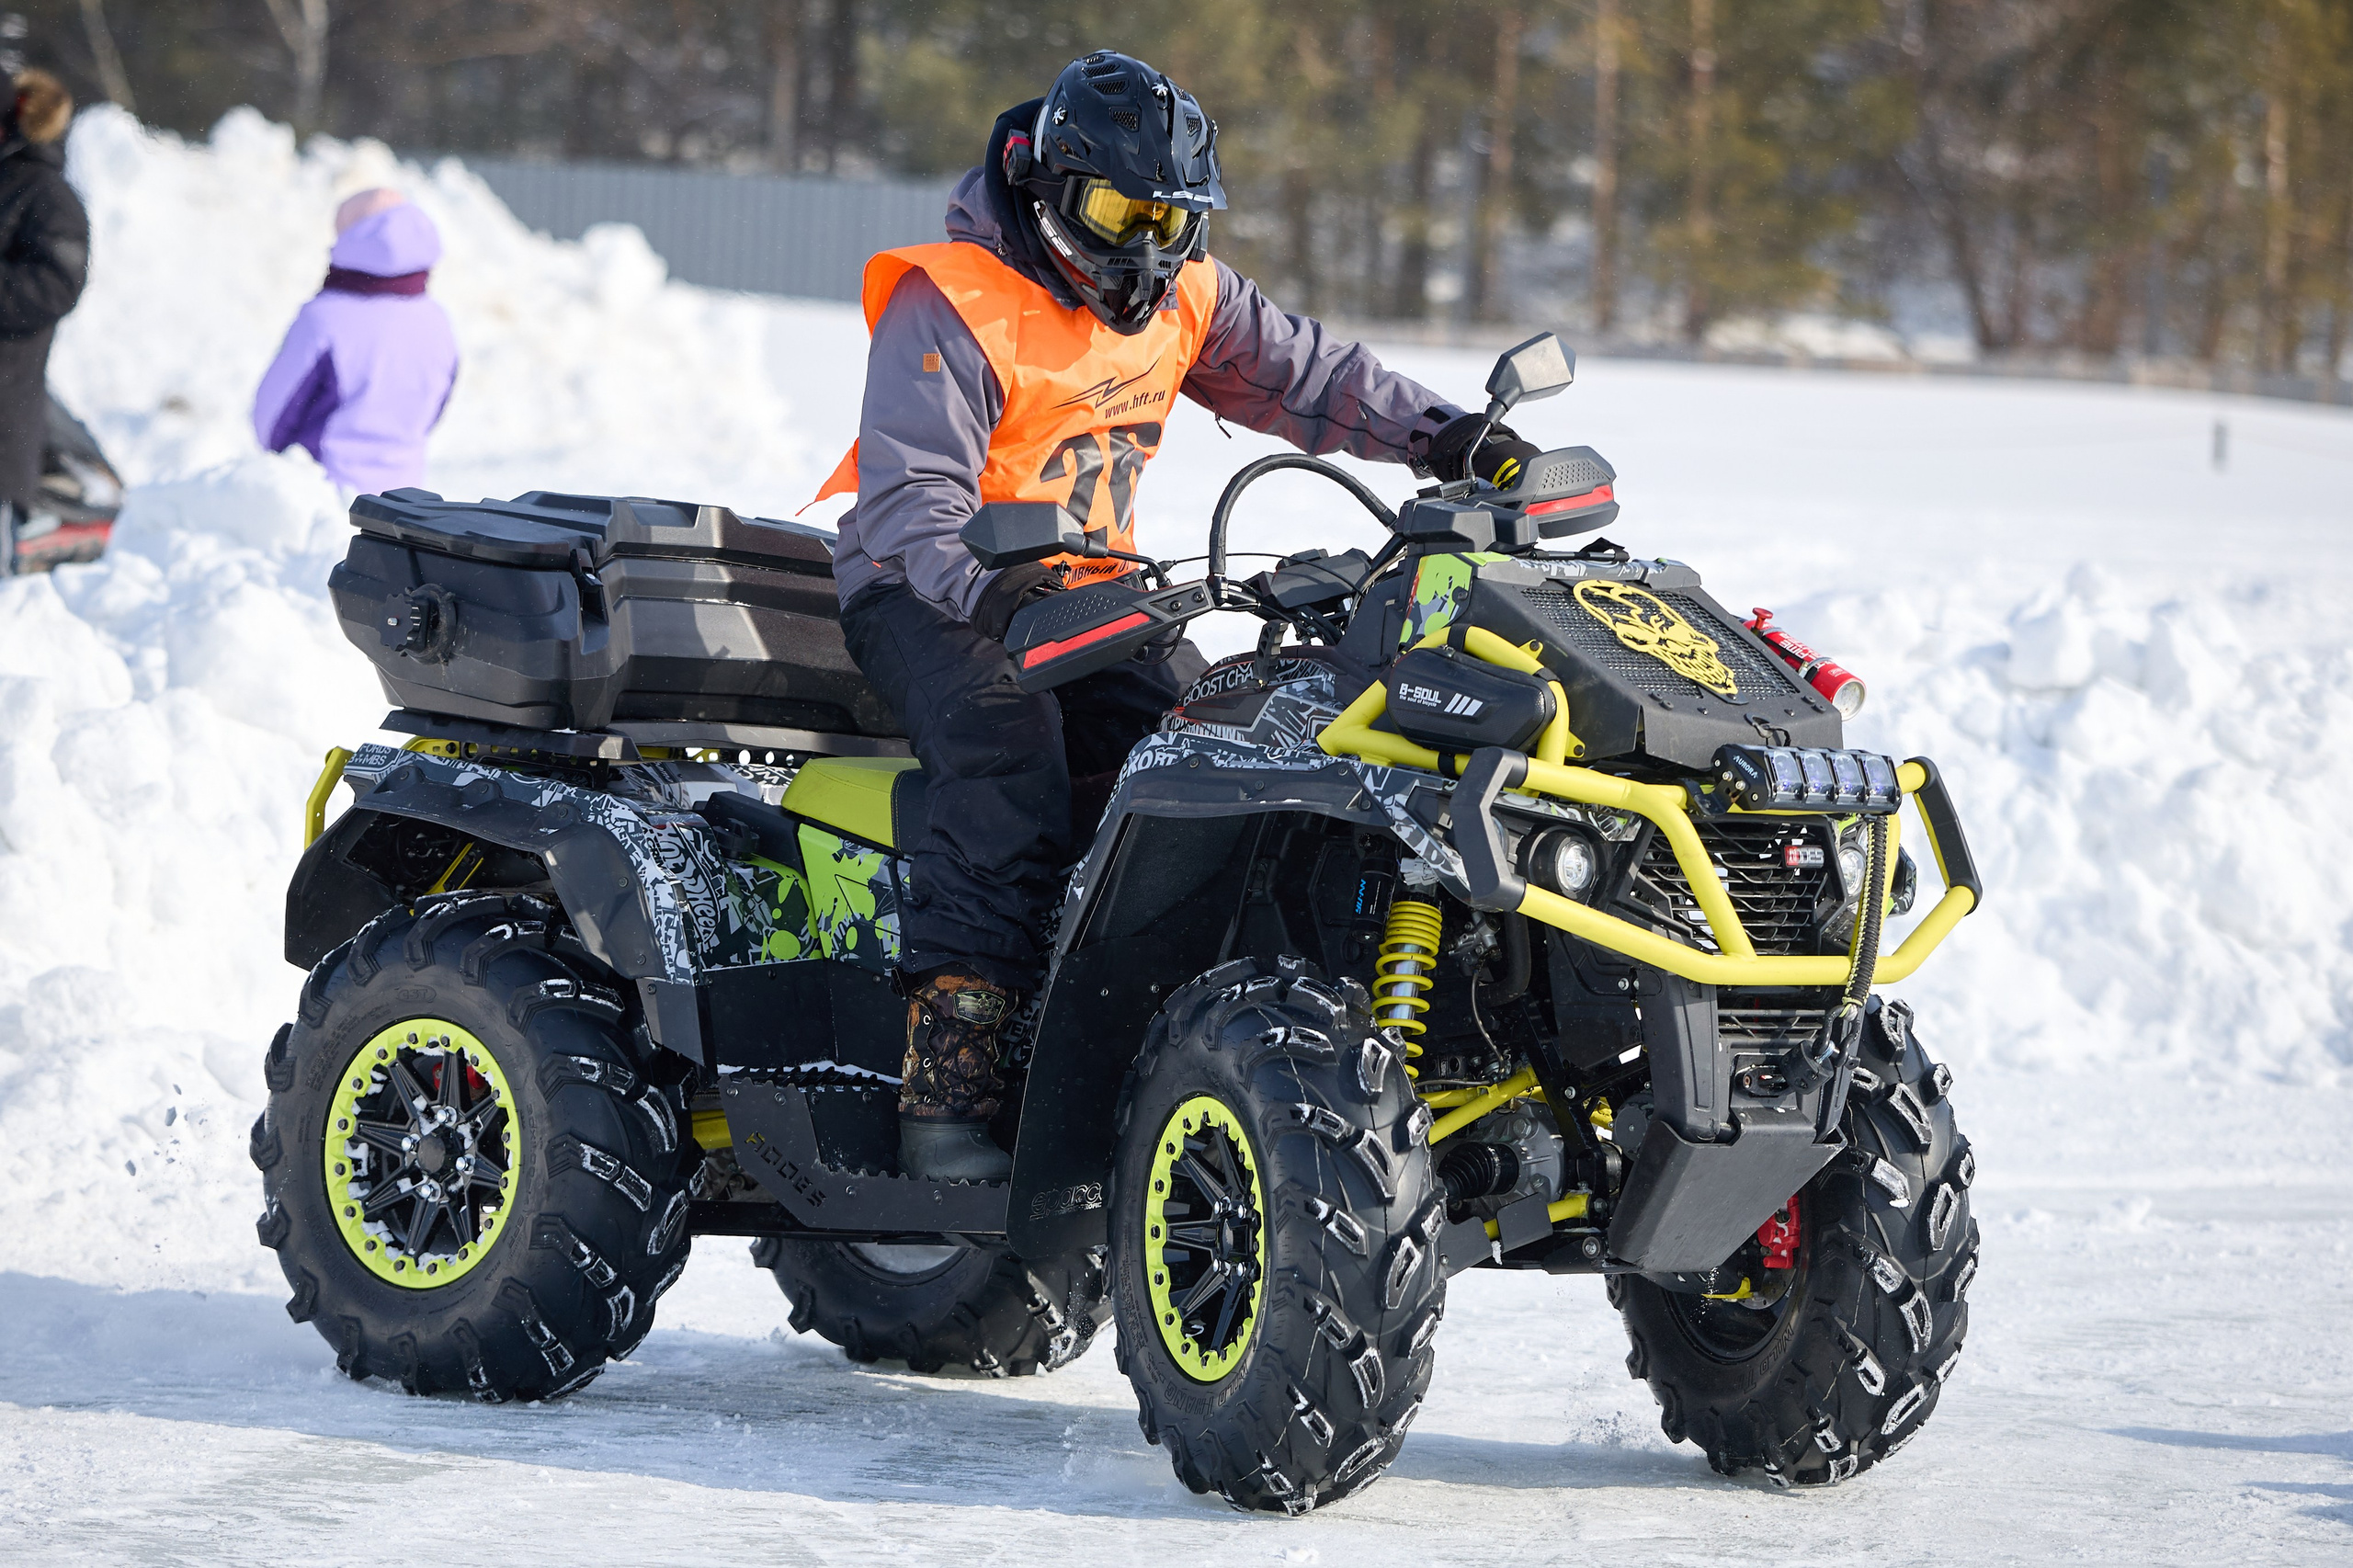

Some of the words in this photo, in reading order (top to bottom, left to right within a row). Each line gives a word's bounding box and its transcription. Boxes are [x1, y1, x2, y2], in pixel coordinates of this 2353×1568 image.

[1033, 200, 1073, 257] LS2
[1105, 390, 1165, 419] www.hft.ru
[1183, 673, 1225, 708] BOOST
[1399, 682, 1441, 704] B-SOUL
[1733, 755, 1759, 779] AURORA
[1760, 1323, 1794, 1376] WILD
[1165, 1381, 1215, 1421] THANG
